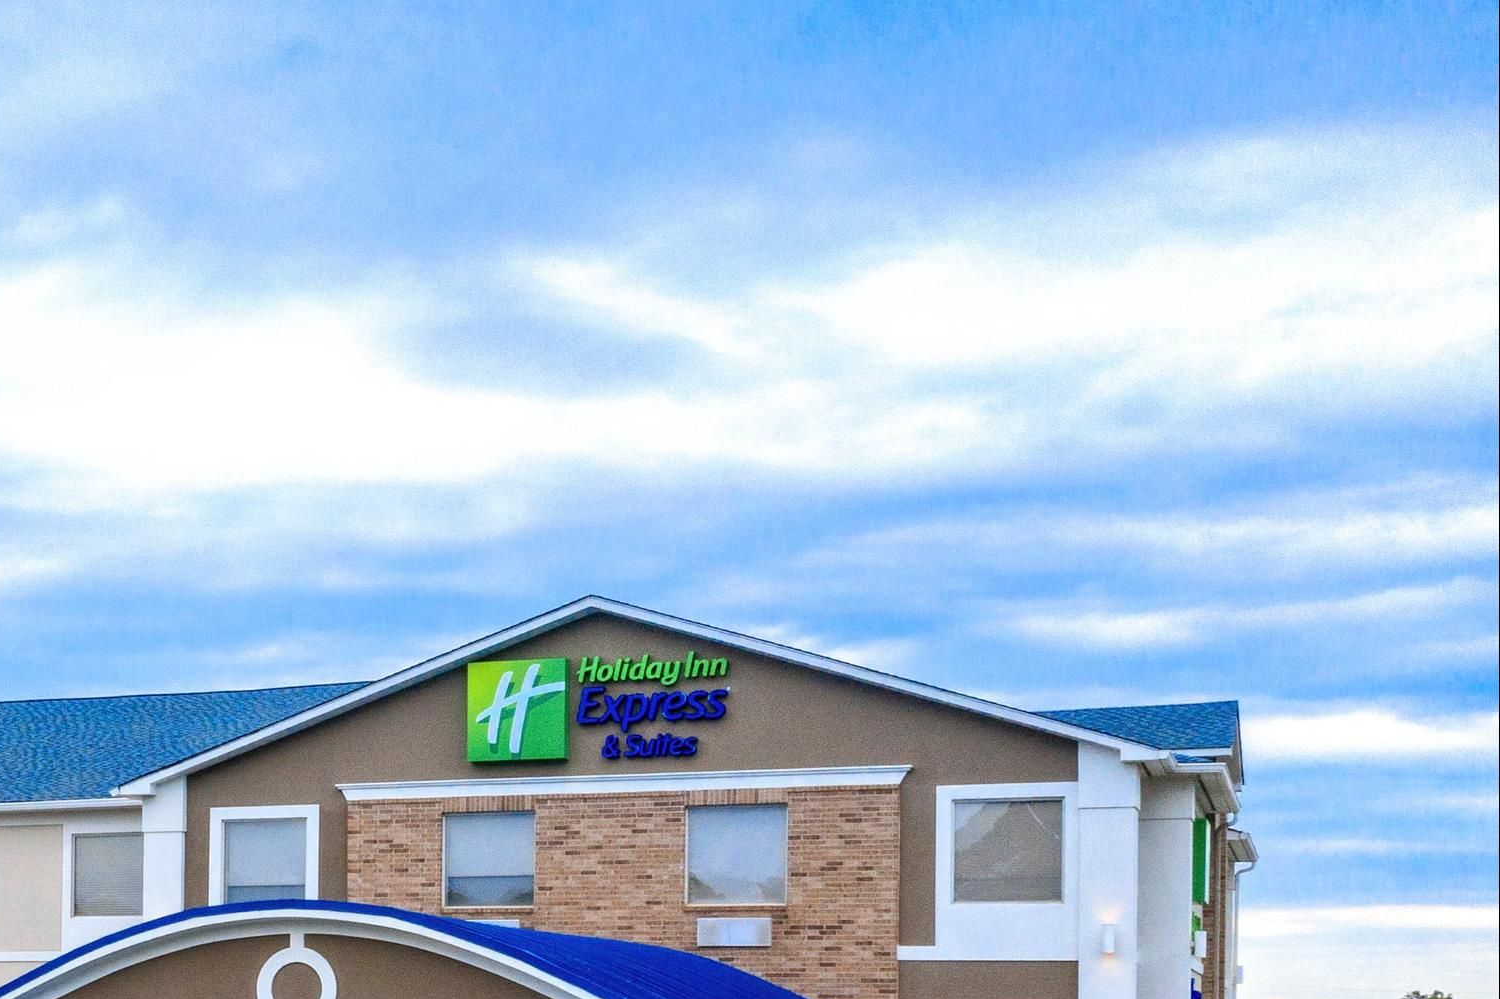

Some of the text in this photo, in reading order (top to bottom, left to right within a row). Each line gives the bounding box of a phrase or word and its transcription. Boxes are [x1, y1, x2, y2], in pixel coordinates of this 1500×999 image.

[576, 651, 728, 686] Holiday Inn
[475, 663, 565, 754] H
[576, 686, 728, 733] Express
[601, 733, 698, 759] & Suites
